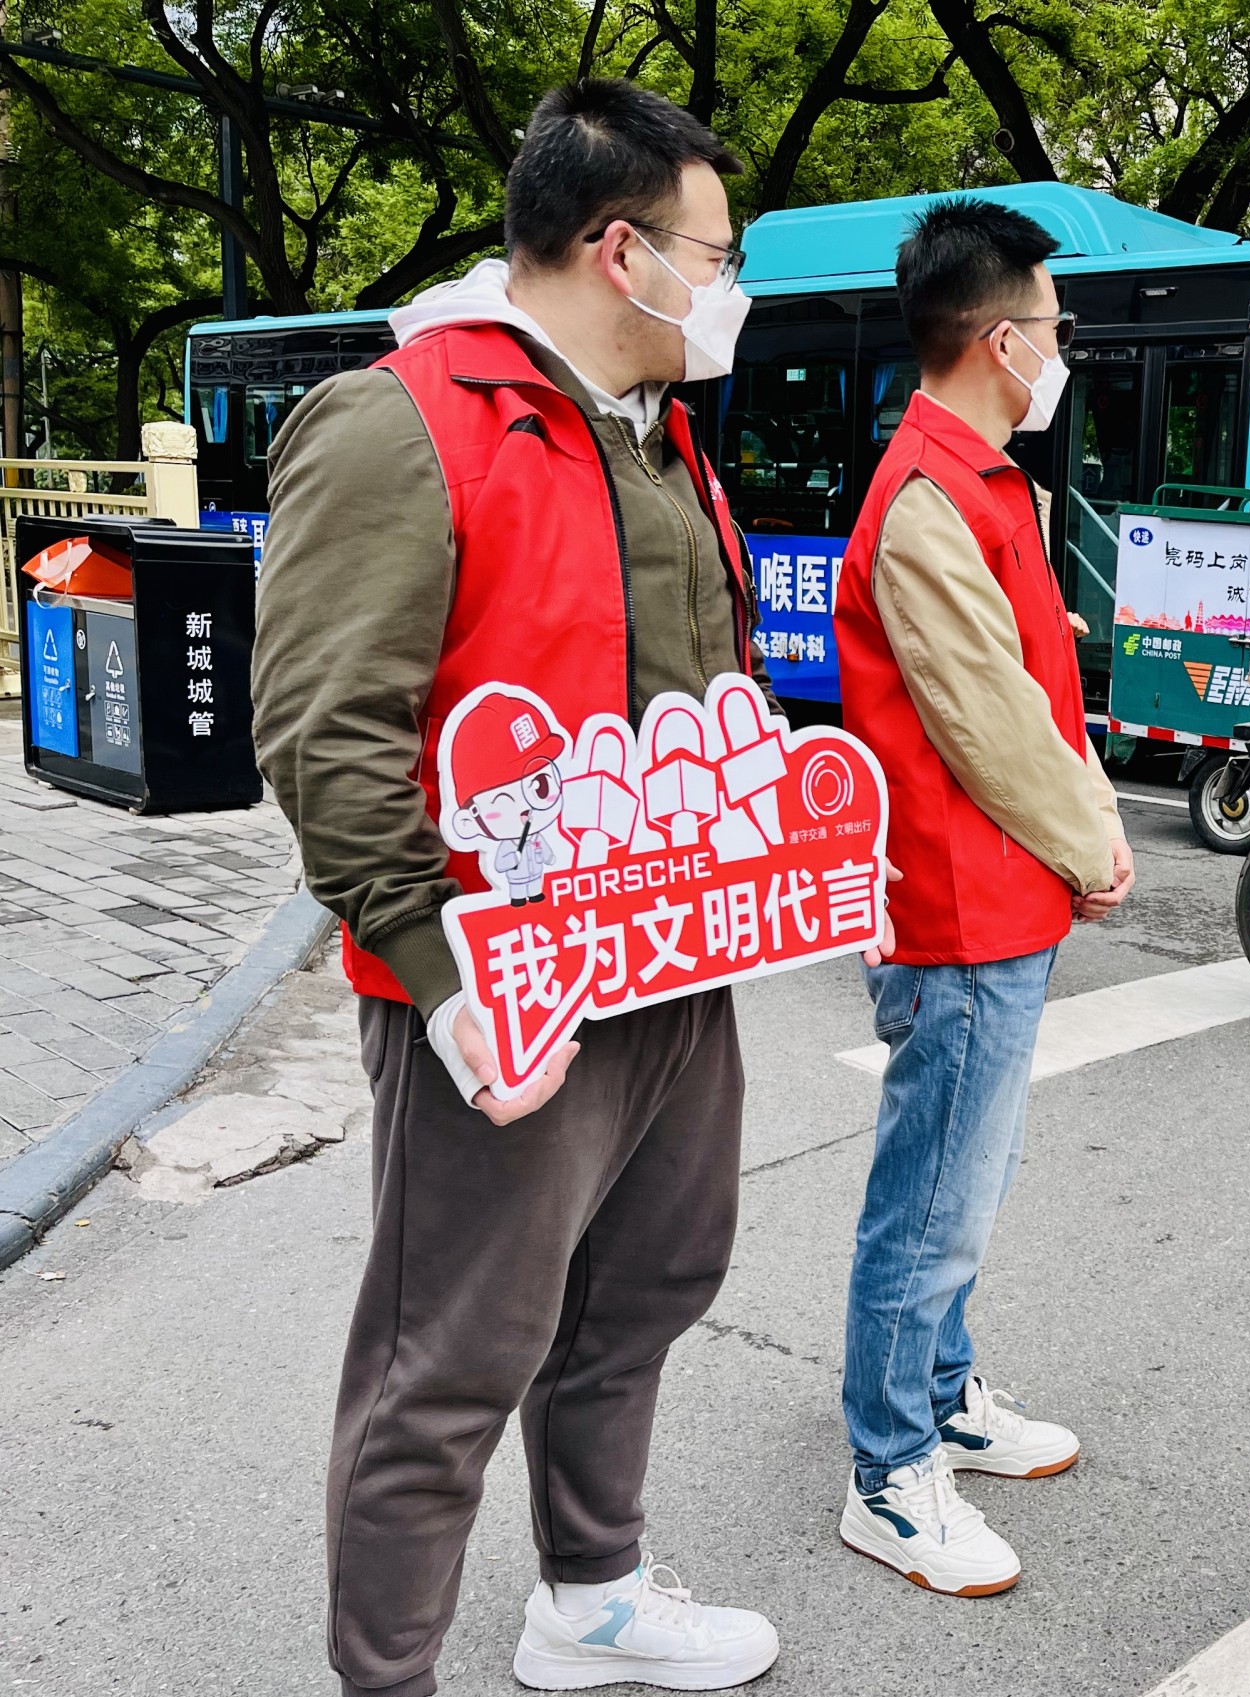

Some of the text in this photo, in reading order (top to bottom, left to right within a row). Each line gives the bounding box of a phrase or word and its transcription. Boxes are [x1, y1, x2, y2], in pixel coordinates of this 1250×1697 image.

[1133, 530, 1151, 545] 快递
[1142, 635, 1182, 653] 中国邮政
[1142, 650, 1181, 660] CHINA POST
[186, 611, 214, 737] 新城城管
[789, 819, 872, 844] 遵守交通 文明出行
[551, 852, 712, 907] PORSCHE
[487, 859, 875, 1012] 我为文明代言
